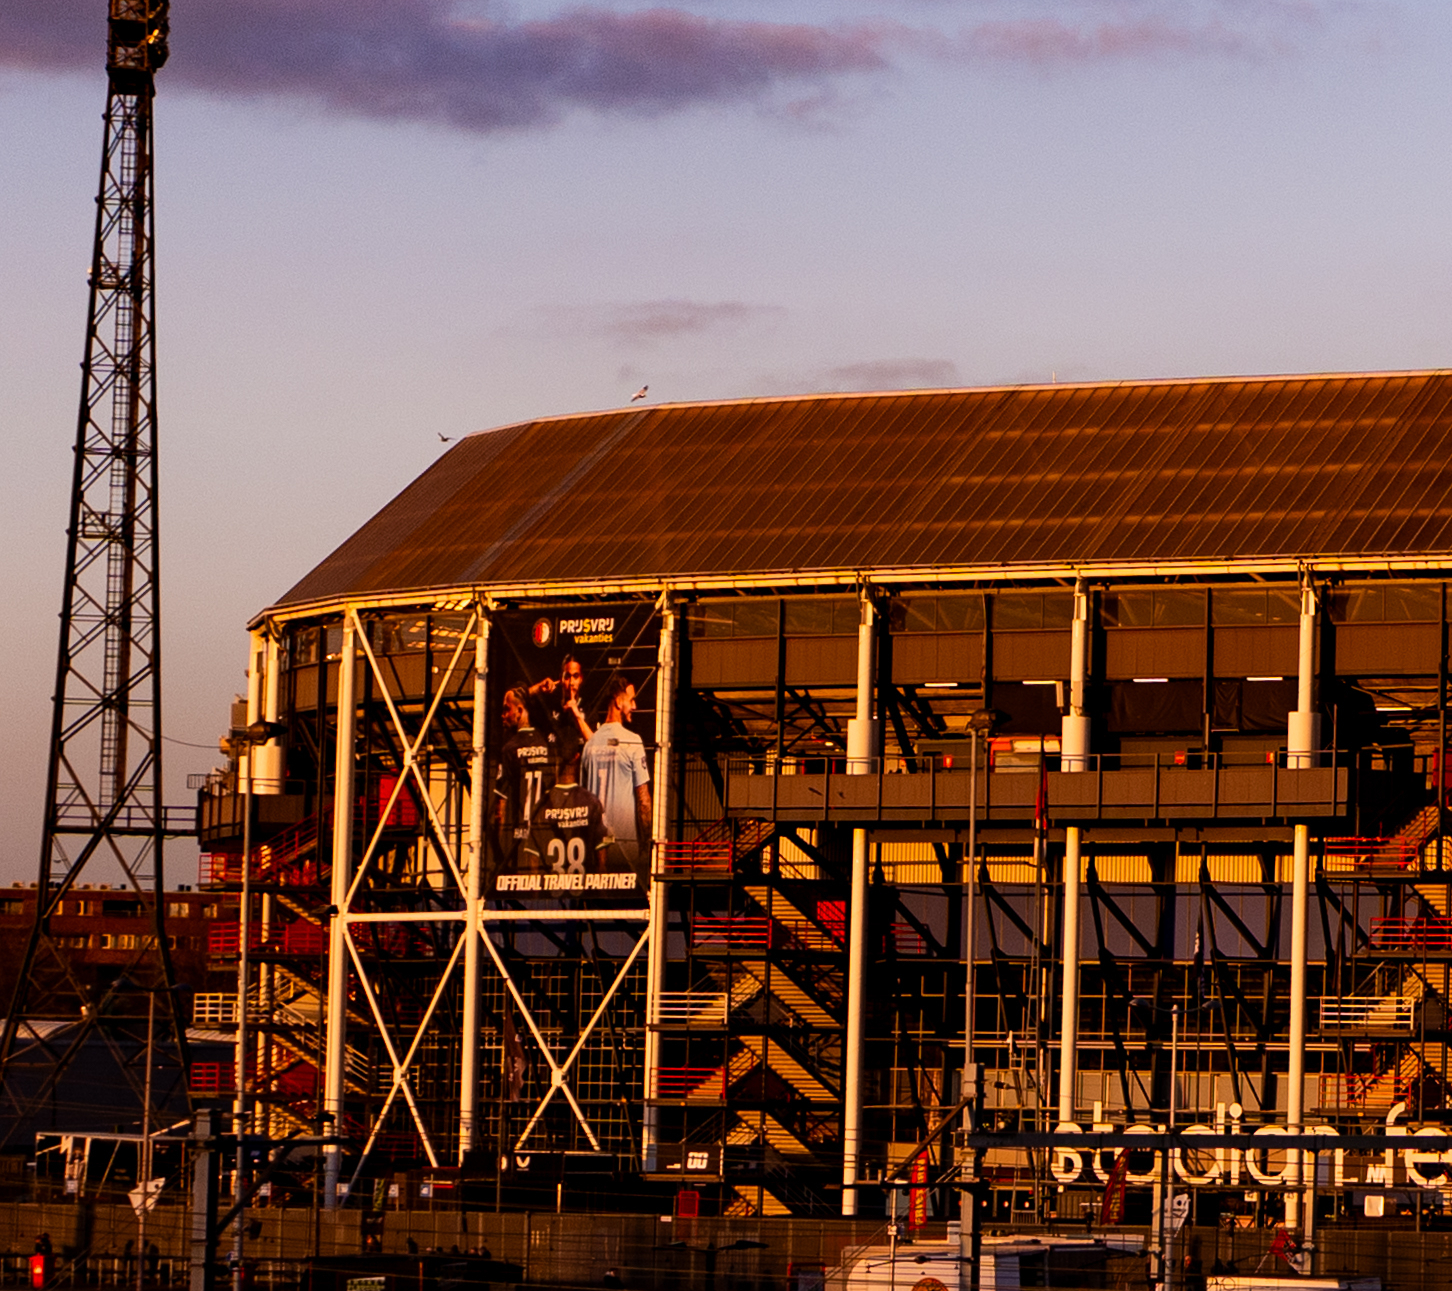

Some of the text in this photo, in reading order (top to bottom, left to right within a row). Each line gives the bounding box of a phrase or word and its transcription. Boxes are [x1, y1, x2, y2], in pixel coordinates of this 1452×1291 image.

[574, 632, 614, 644] vakanties
[543, 874, 584, 891] TRAVEL
[584, 873, 637, 890] PARTNER
[1050, 1101, 1345, 1187] stadion
